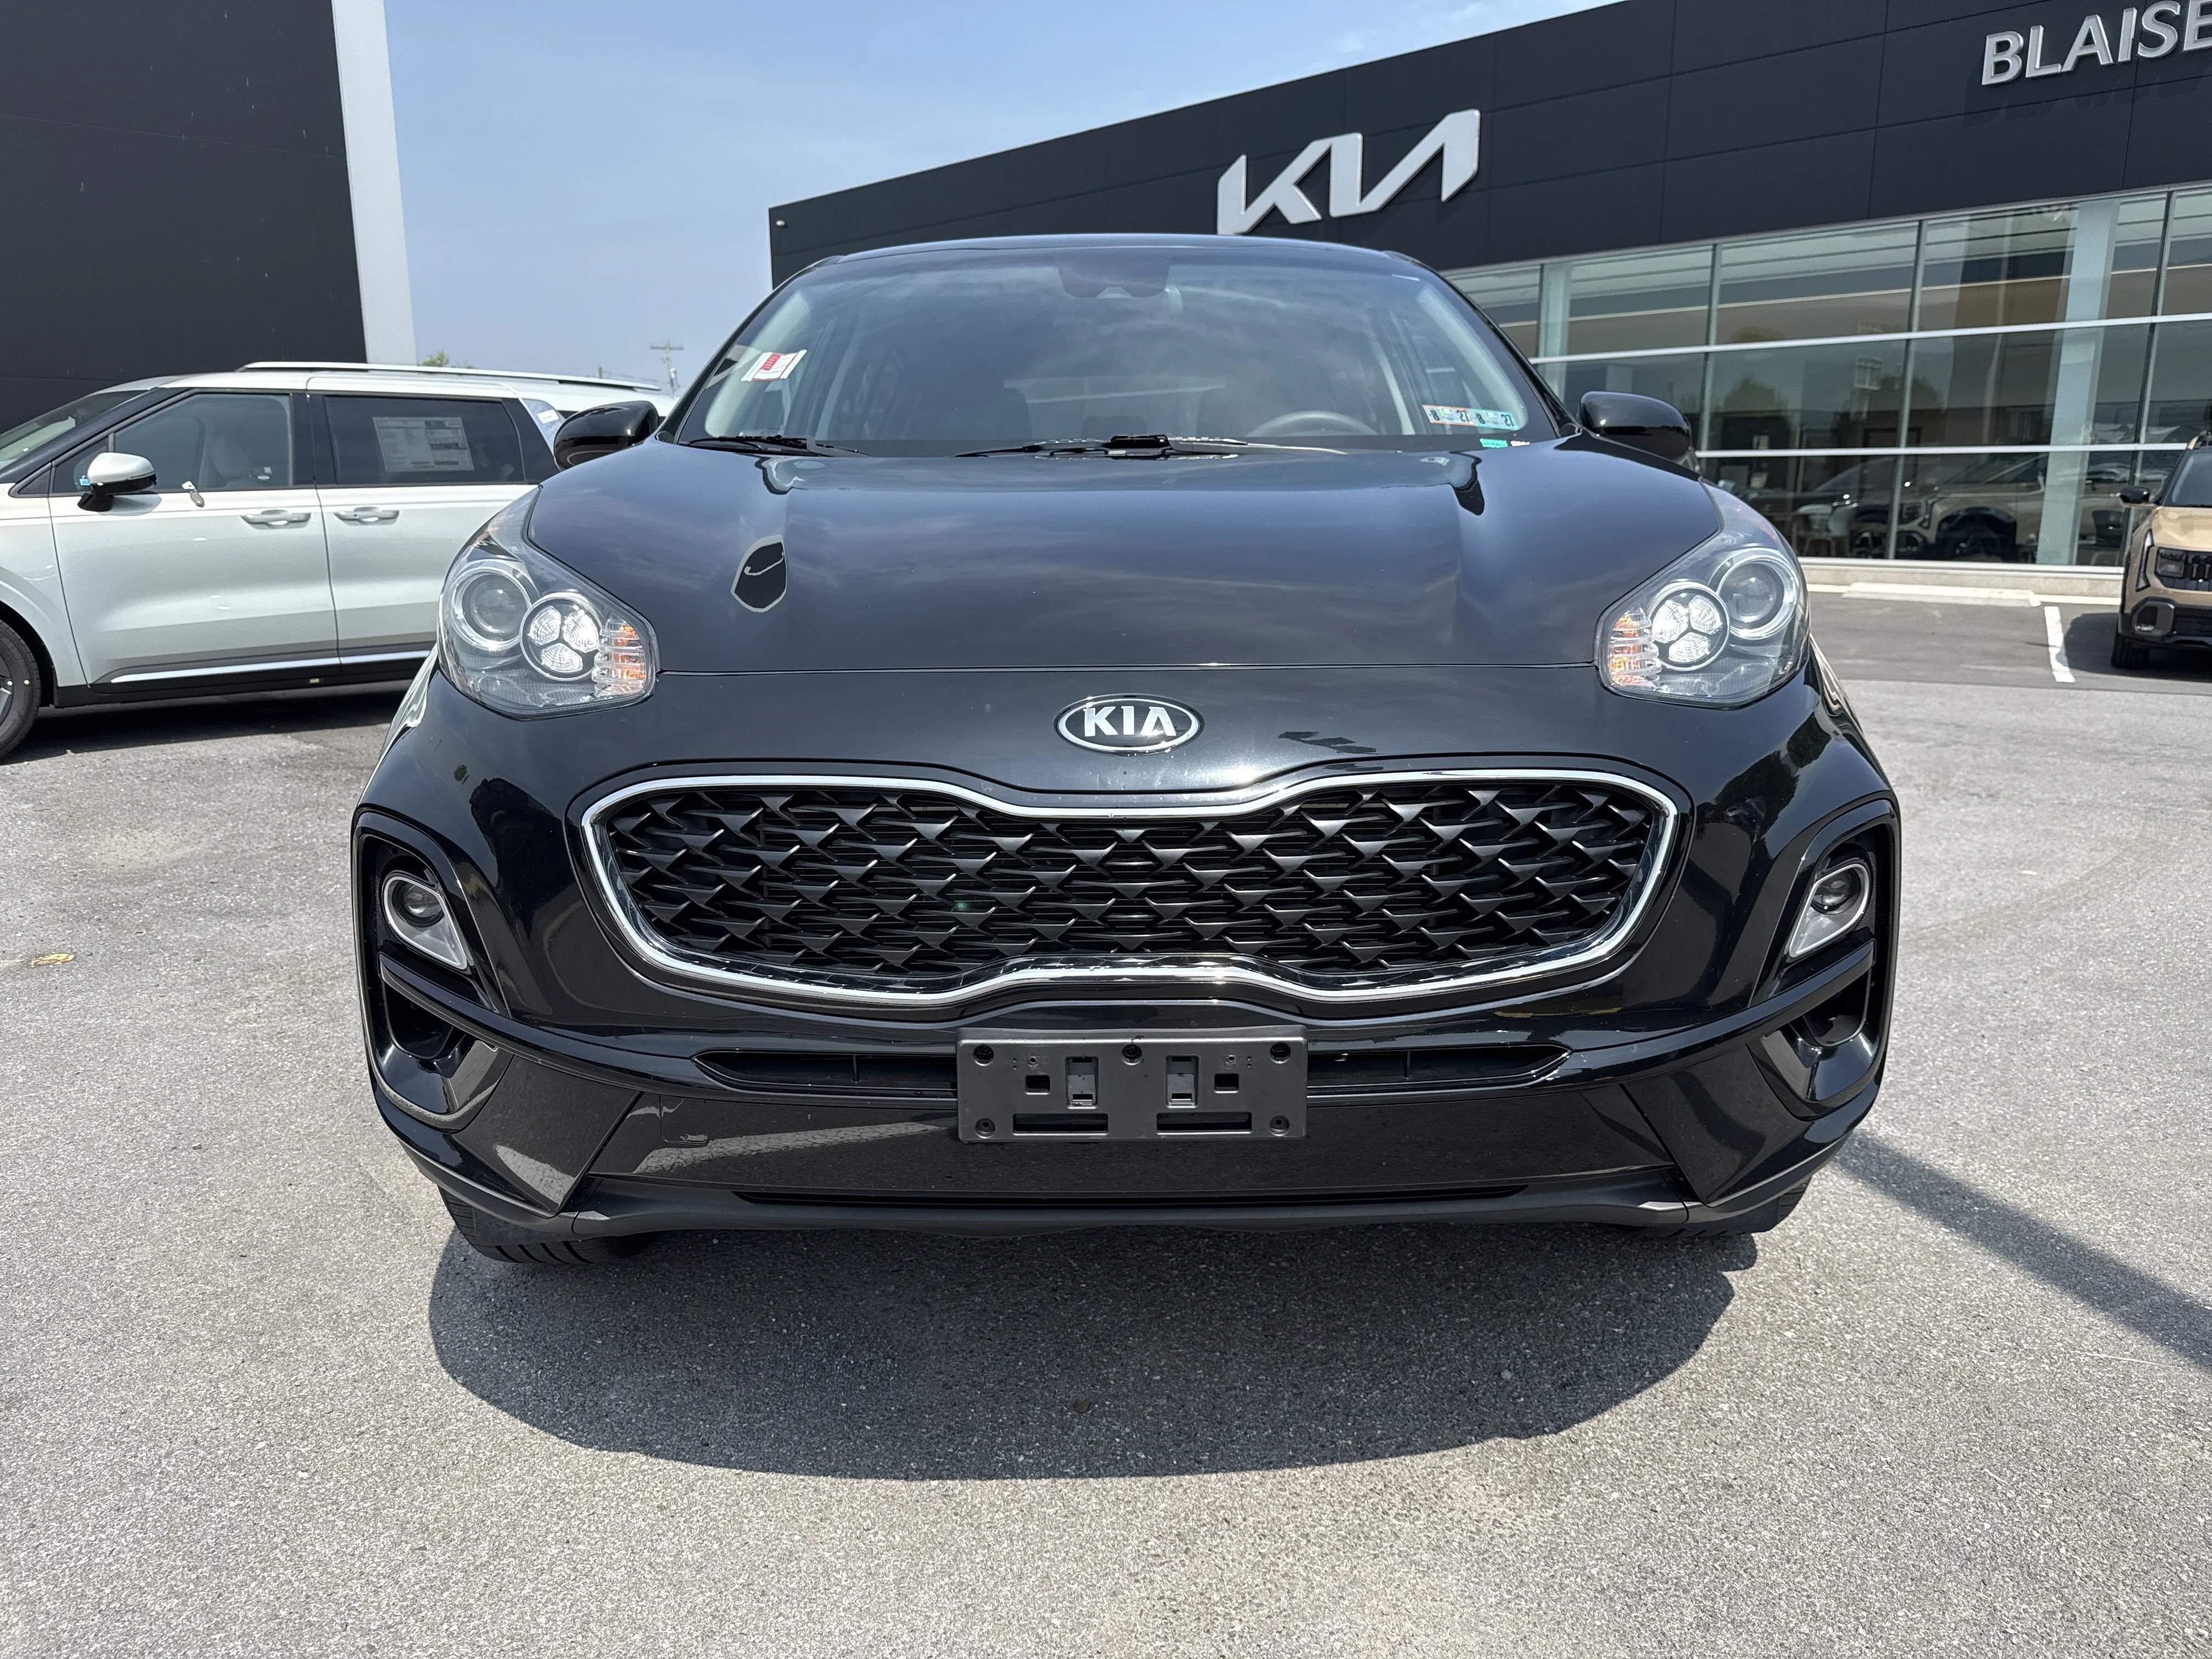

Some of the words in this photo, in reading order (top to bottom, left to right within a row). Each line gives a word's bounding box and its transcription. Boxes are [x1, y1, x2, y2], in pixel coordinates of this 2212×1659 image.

[1982, 0, 2212, 86] BLAISE
[1217, 109, 1480, 235] KIA
[1430, 410, 1440, 421] 8
[1475, 413, 1486, 425] 8
[1083, 706, 1176, 737] KIA
